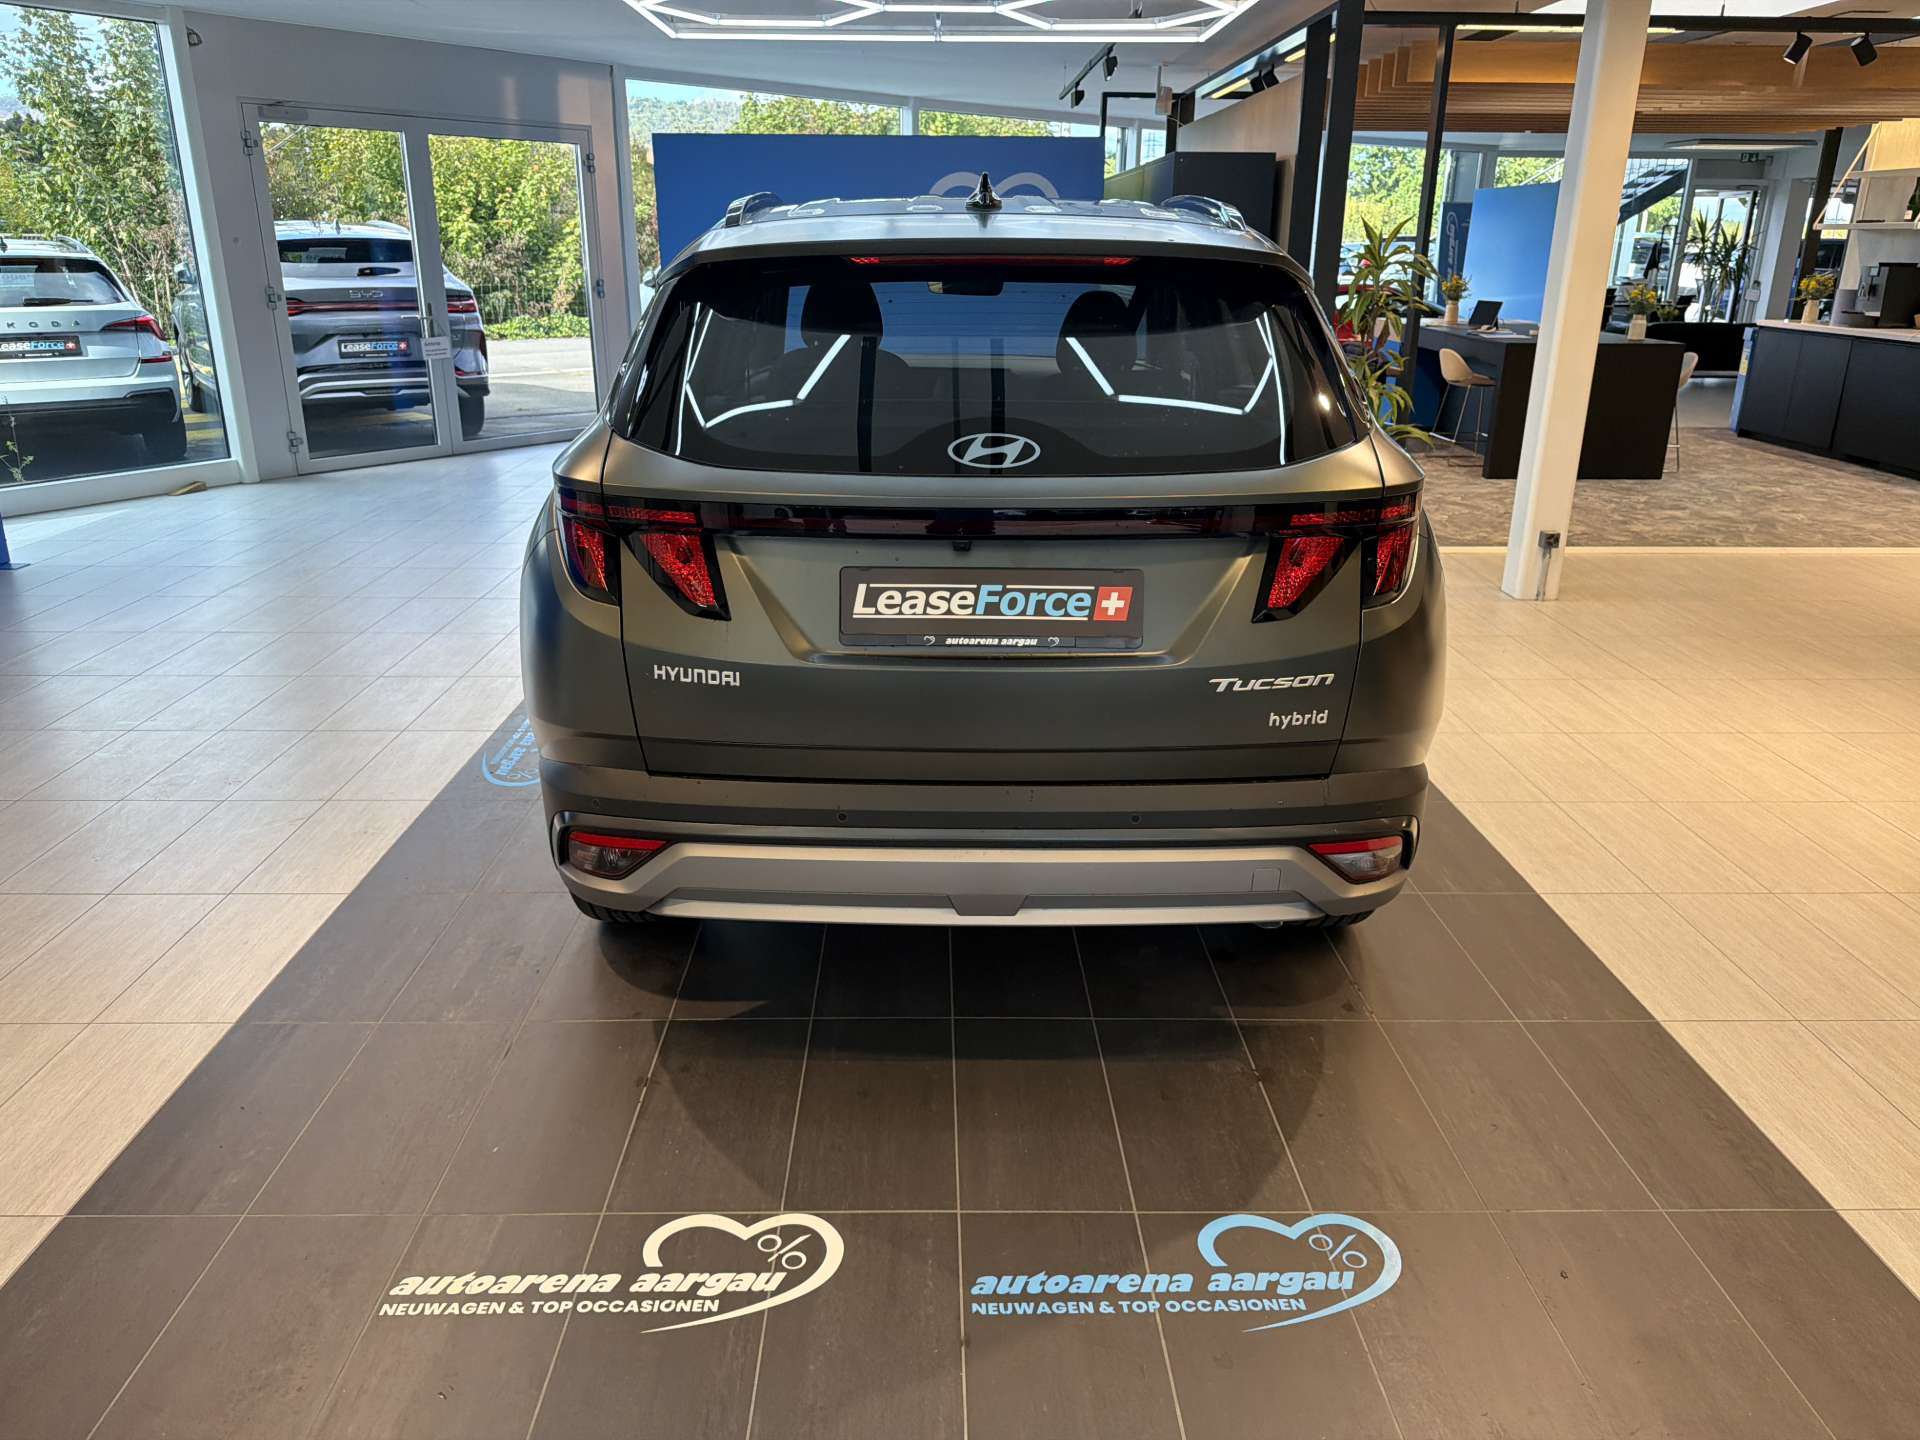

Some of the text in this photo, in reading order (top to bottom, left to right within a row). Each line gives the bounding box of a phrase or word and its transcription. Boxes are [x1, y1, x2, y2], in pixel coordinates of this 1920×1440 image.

[5, 320, 81, 329] KODA
[0, 341, 65, 352] easeForce
[341, 341, 399, 353] LeaseForce
[852, 583, 1092, 617] LeaseForce
[945, 637, 1038, 646] autoarena aargau
[653, 664, 740, 686] HYUNDAI
[1268, 709, 1329, 730] hybrid
[389, 1271, 787, 1297] autoarena aargau
[970, 1270, 1355, 1296] autoarena aargau
[379, 1299, 719, 1316] NEUWAGEN & TOP OCCASIONEN
[971, 1299, 1307, 1315] NEUWAGEN & TOP OCCASIONEN
